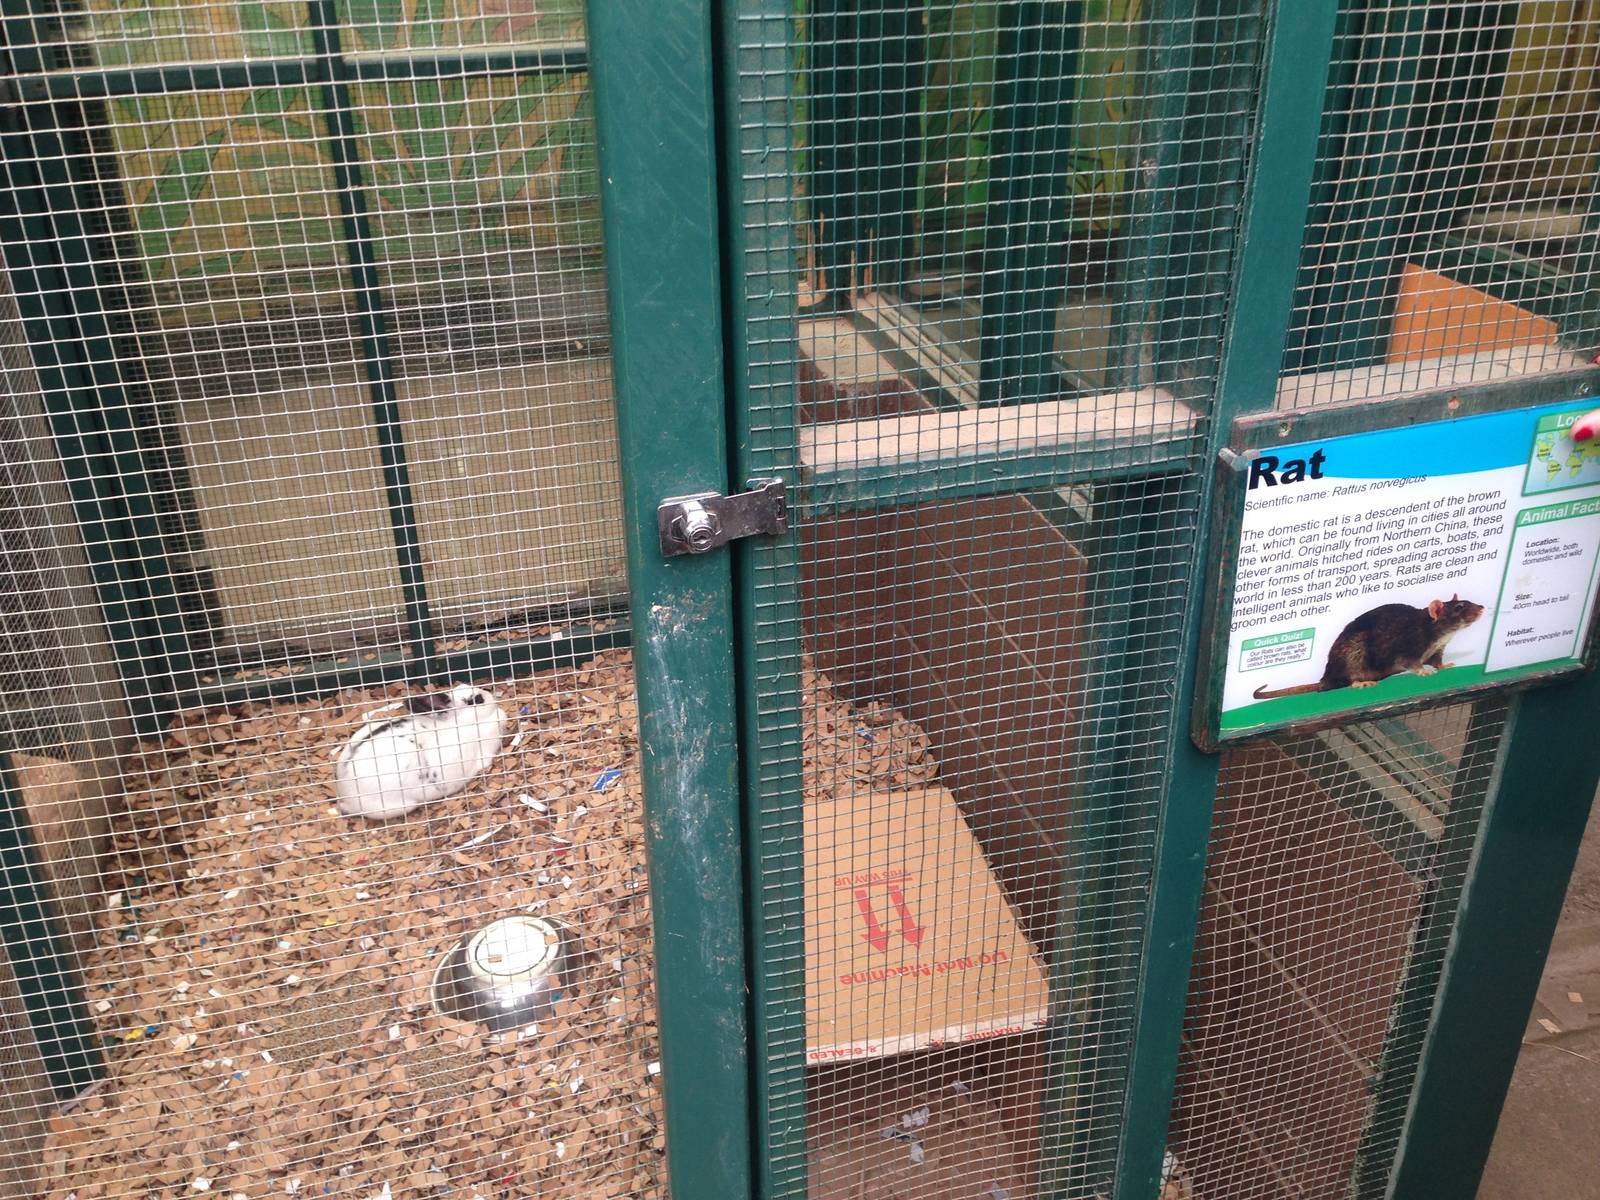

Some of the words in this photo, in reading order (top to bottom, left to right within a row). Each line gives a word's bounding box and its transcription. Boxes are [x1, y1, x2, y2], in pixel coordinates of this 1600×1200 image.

[1249, 448, 1326, 490] Rat
[1245, 495, 1294, 512] Scientific
[1297, 490, 1330, 503] name:
[1332, 483, 1367, 497] Rattus
[1370, 474, 1427, 490] norvegicus
[1243, 530, 1264, 541] The
[1268, 520, 1320, 537] domestic
[1323, 517, 1338, 527] rat
[1342, 514, 1351, 524] is
[1354, 513, 1362, 522] a
[1365, 501, 1430, 520] descendent
[1434, 498, 1446, 509] of
[1448, 496, 1464, 506] the
[1468, 490, 1501, 504] brown
[1522, 506, 1568, 522] Animal
[1240, 544, 1258, 555] rat,
[1263, 537, 1296, 550] which
[1300, 533, 1320, 544] can
[1324, 529, 1338, 540] be
[1342, 522, 1372, 536] found
[1376, 516, 1404, 531] living
[1408, 515, 1418, 525] in
[1422, 510, 1449, 522] cities
[1452, 507, 1466, 518] all
[1468, 500, 1506, 516] around
[1238, 558, 1256, 568] the
[1260, 552, 1294, 564] world.
[1298, 539, 1351, 557] Originally
[1354, 535, 1380, 548] from
[1383, 526, 1431, 542] Northern
[1434, 520, 1469, 534] China,
[1473, 514, 1503, 527] these
[1526, 537, 1560, 549] Location:
[1237, 568, 1274, 580] clever
[1275, 558, 1318, 573] animals
[1322, 550, 1363, 565] hitched
[1366, 546, 1393, 557] rides
[1397, 543, 1410, 552] on
[1414, 538, 1444, 550] carts,
[1446, 532, 1480, 544] boats,
[1483, 525, 1504, 537] and
[1522, 556, 1553, 566] domestic
[1554, 552, 1568, 560] and
[1569, 548, 1584, 556] wild
[1524, 546, 1561, 558] Worldwide,
[1563, 542, 1579, 551] both
[1236, 579, 1268, 592] other
[1268, 573, 1300, 587] forms
[1303, 570, 1314, 580] of
[1318, 562, 1370, 578] transport,
[1373, 552, 1428, 570] spreading
[1431, 545, 1466, 558] across
[1470, 541, 1487, 550] the
[1234, 590, 1264, 605] world
[1268, 588, 1278, 599] in
[1281, 584, 1304, 596] less
[1308, 580, 1332, 592] than
[1334, 575, 1356, 588] 200
[1359, 571, 1392, 586] years.
[1396, 564, 1422, 576] Rats
[1424, 560, 1442, 571] are
[1446, 555, 1474, 568] clean
[1477, 549, 1498, 562] and
[1232, 599, 1286, 618] intelligent
[1289, 592, 1332, 608] animals
[1336, 588, 1358, 599] who
[1362, 582, 1380, 594] like
[1384, 581, 1394, 590] to
[1397, 572, 1444, 588] socialise
[1446, 567, 1468, 579] and
[1515, 593, 1533, 601] Size:
[1512, 602, 1532, 610] 40cm
[1532, 598, 1550, 606] head
[1560, 594, 1570, 602] tail
[1231, 617, 1266, 632] groom
[1270, 610, 1297, 623] each
[1300, 604, 1332, 618] other.
[1505, 637, 1538, 647] Wherever
[1538, 632, 1560, 642] people
[1507, 627, 1535, 638] Habitat:
[1254, 637, 1278, 647] Quick
[834, 877, 851, 887] UP
[855, 873, 880, 884] WAY
[936, 956, 975, 973] Not
[980, 951, 1010, 962] Do
[839, 963, 932, 986] Machine
[964, 1026, 1023, 1041] FRAGILE
